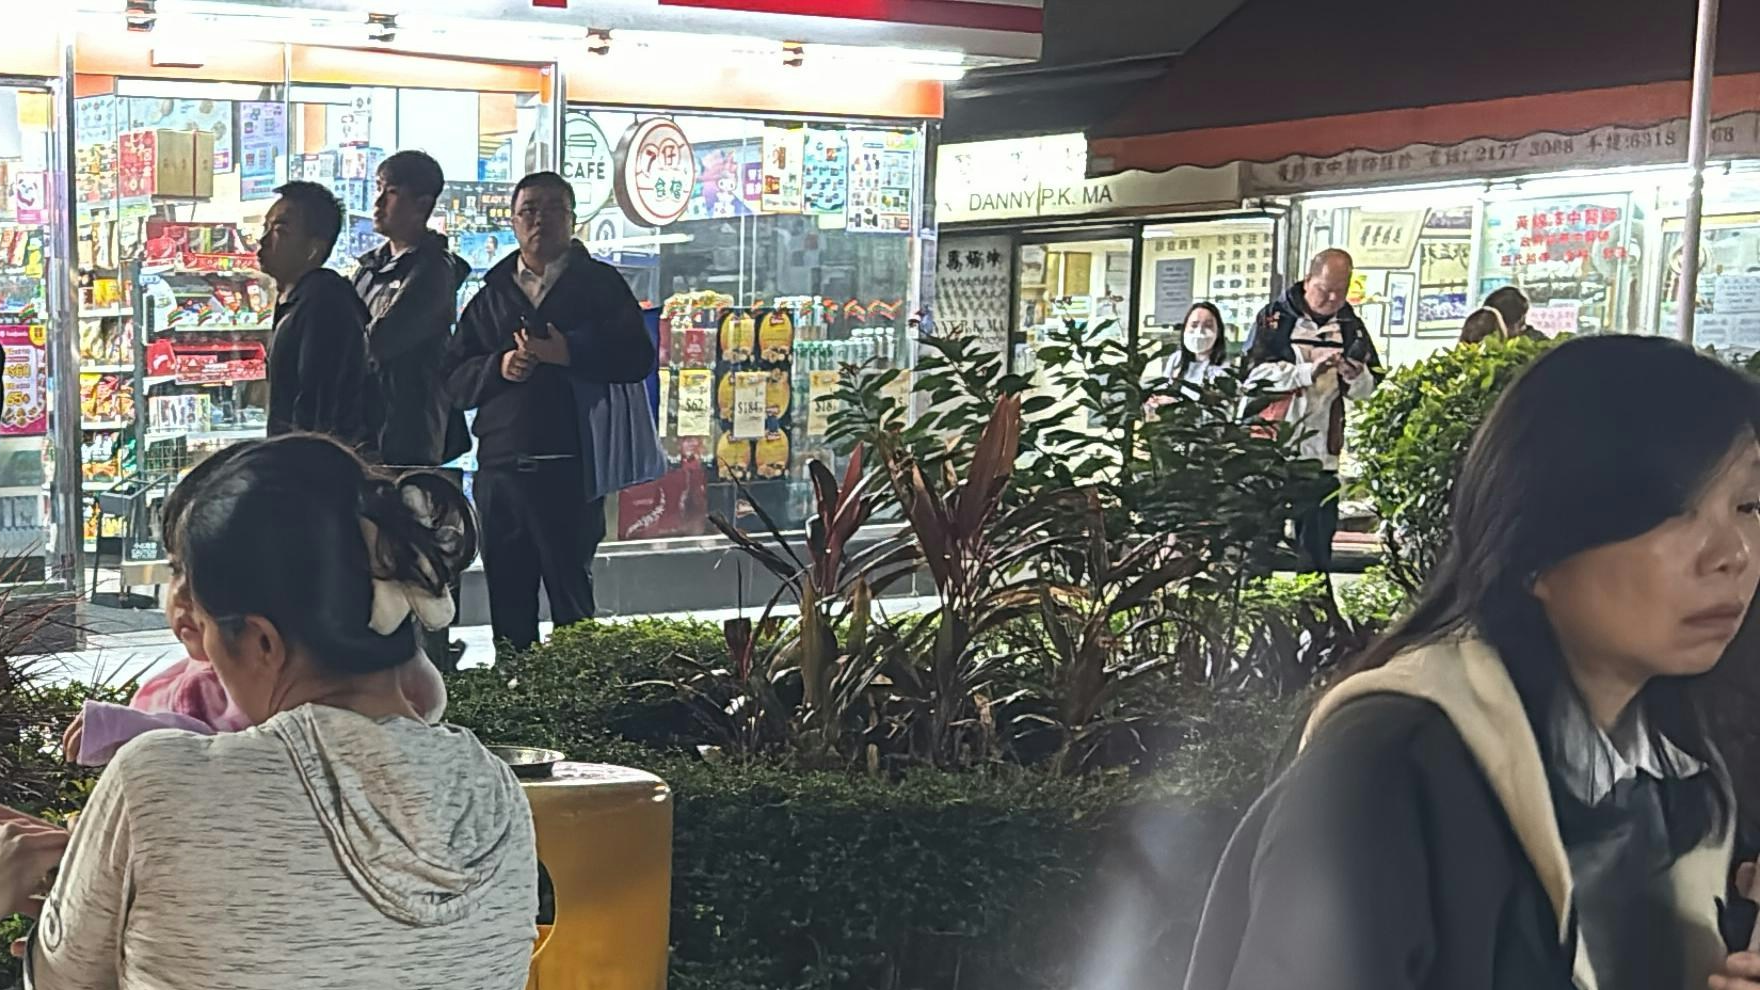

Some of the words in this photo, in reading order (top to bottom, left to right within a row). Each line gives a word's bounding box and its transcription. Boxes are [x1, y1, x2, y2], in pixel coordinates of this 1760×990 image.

[563, 156, 606, 180] CAFÉ
[969, 190, 1036, 211] DANNY
[1041, 186, 1077, 206] P.K.
[1083, 185, 1113, 204] MA
